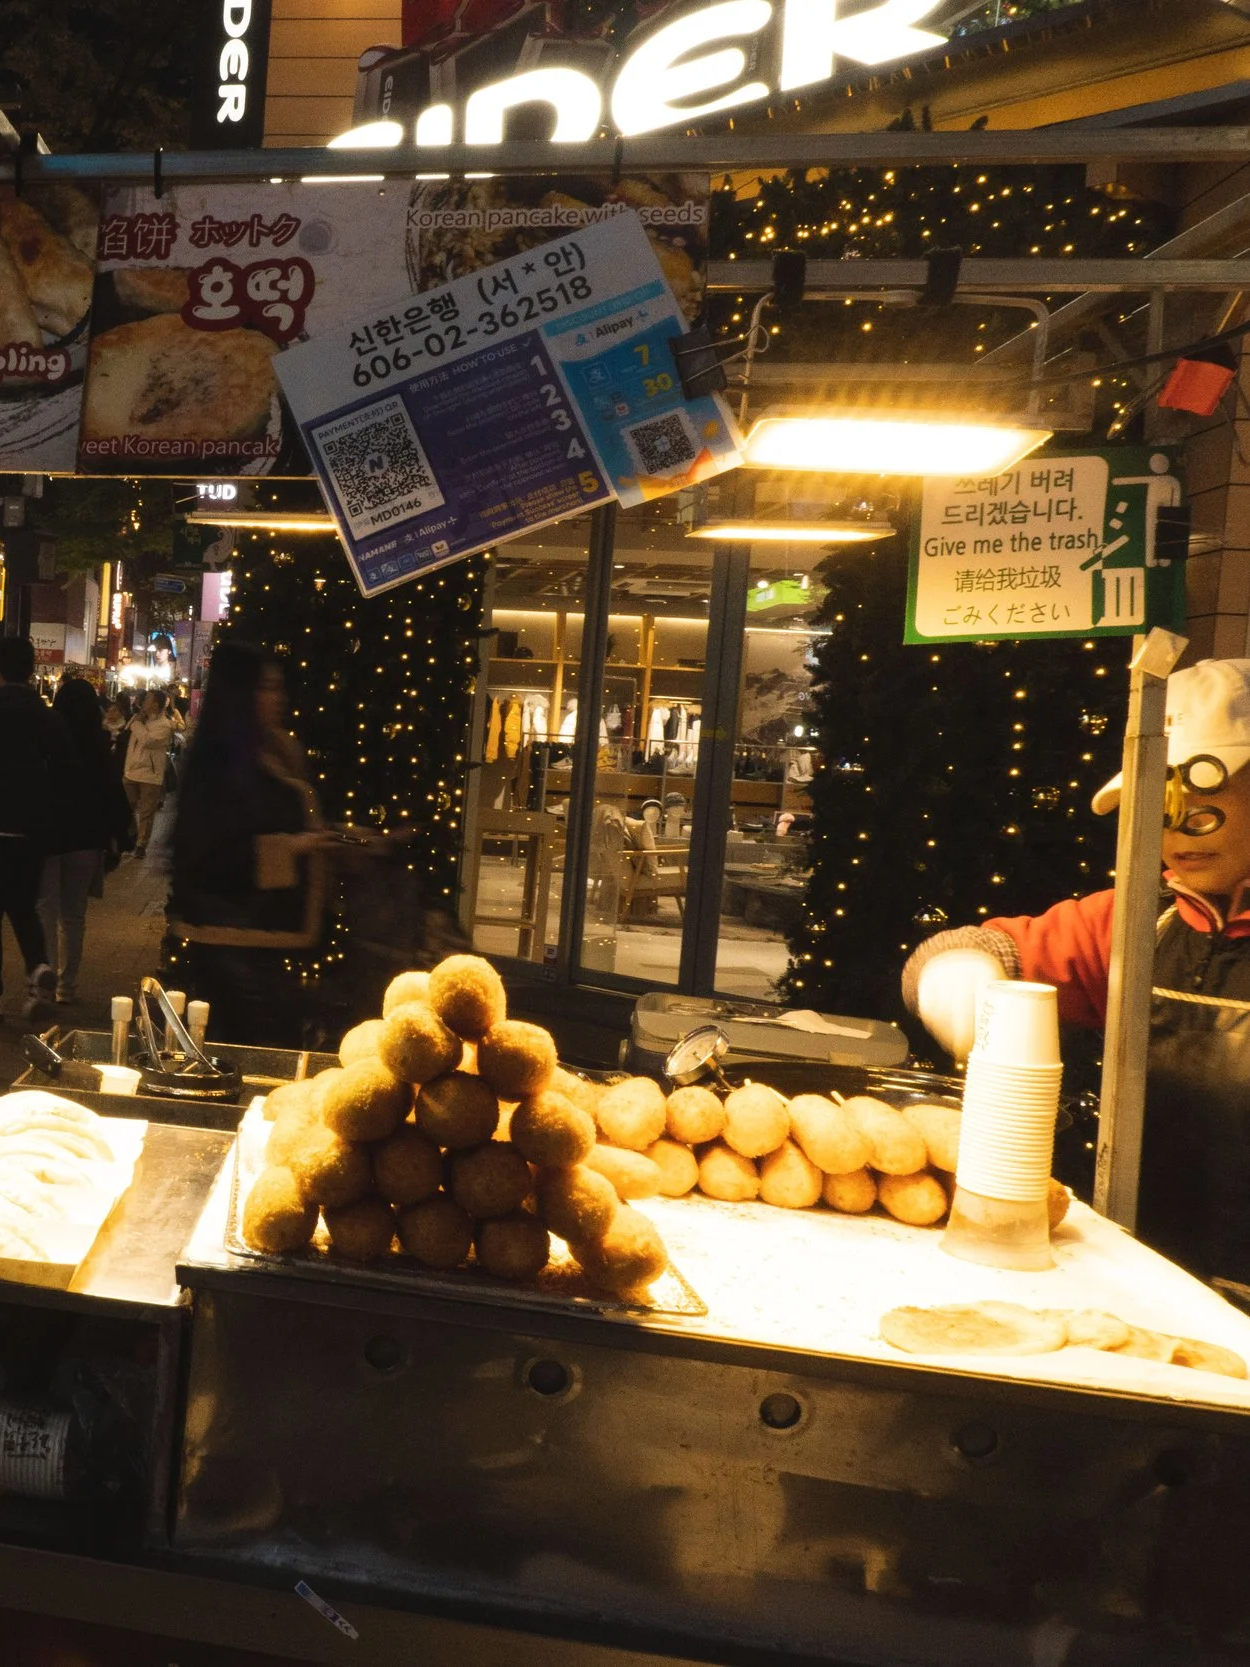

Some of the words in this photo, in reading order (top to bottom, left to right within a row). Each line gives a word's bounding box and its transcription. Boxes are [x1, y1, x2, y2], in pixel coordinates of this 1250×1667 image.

[193, 215, 300, 246] ホットク
[406, 209, 481, 227] Korean
[488, 205, 579, 232] pancake
[642, 203, 703, 225] seeds
[190, 263, 306, 332] 호떡
[348, 292, 461, 358] 신한은행
[543, 242, 588, 278] 안)
[352, 276, 593, 389] 606-02-362518
[595, 315, 634, 339] Alipay
[451, 359, 481, 376] HOW
[479, 352, 496, 364] TO
[494, 343, 517, 358] USE
[529, 354, 550, 378] 1
[539, 383, 563, 407] 2
[550, 408, 573, 432] 3
[81, 437, 117, 456] eet
[124, 436, 195, 454] Korean
[202, 436, 279, 460] pancak
[565, 438, 588, 462] 4
[577, 470, 600, 496] 5
[1030, 468, 1075, 493] 버려
[370, 497, 422, 525] MD0146
[941, 498, 1084, 526] 드리겠습니다.
[924, 537, 966, 557] Give
[973, 540, 1004, 555] me
[1009, 532, 1043, 552] the
[1048, 527, 1100, 551] trash
[955, 566, 1062, 593] 请给我垃圾
[943, 603, 1070, 626] ごみください
